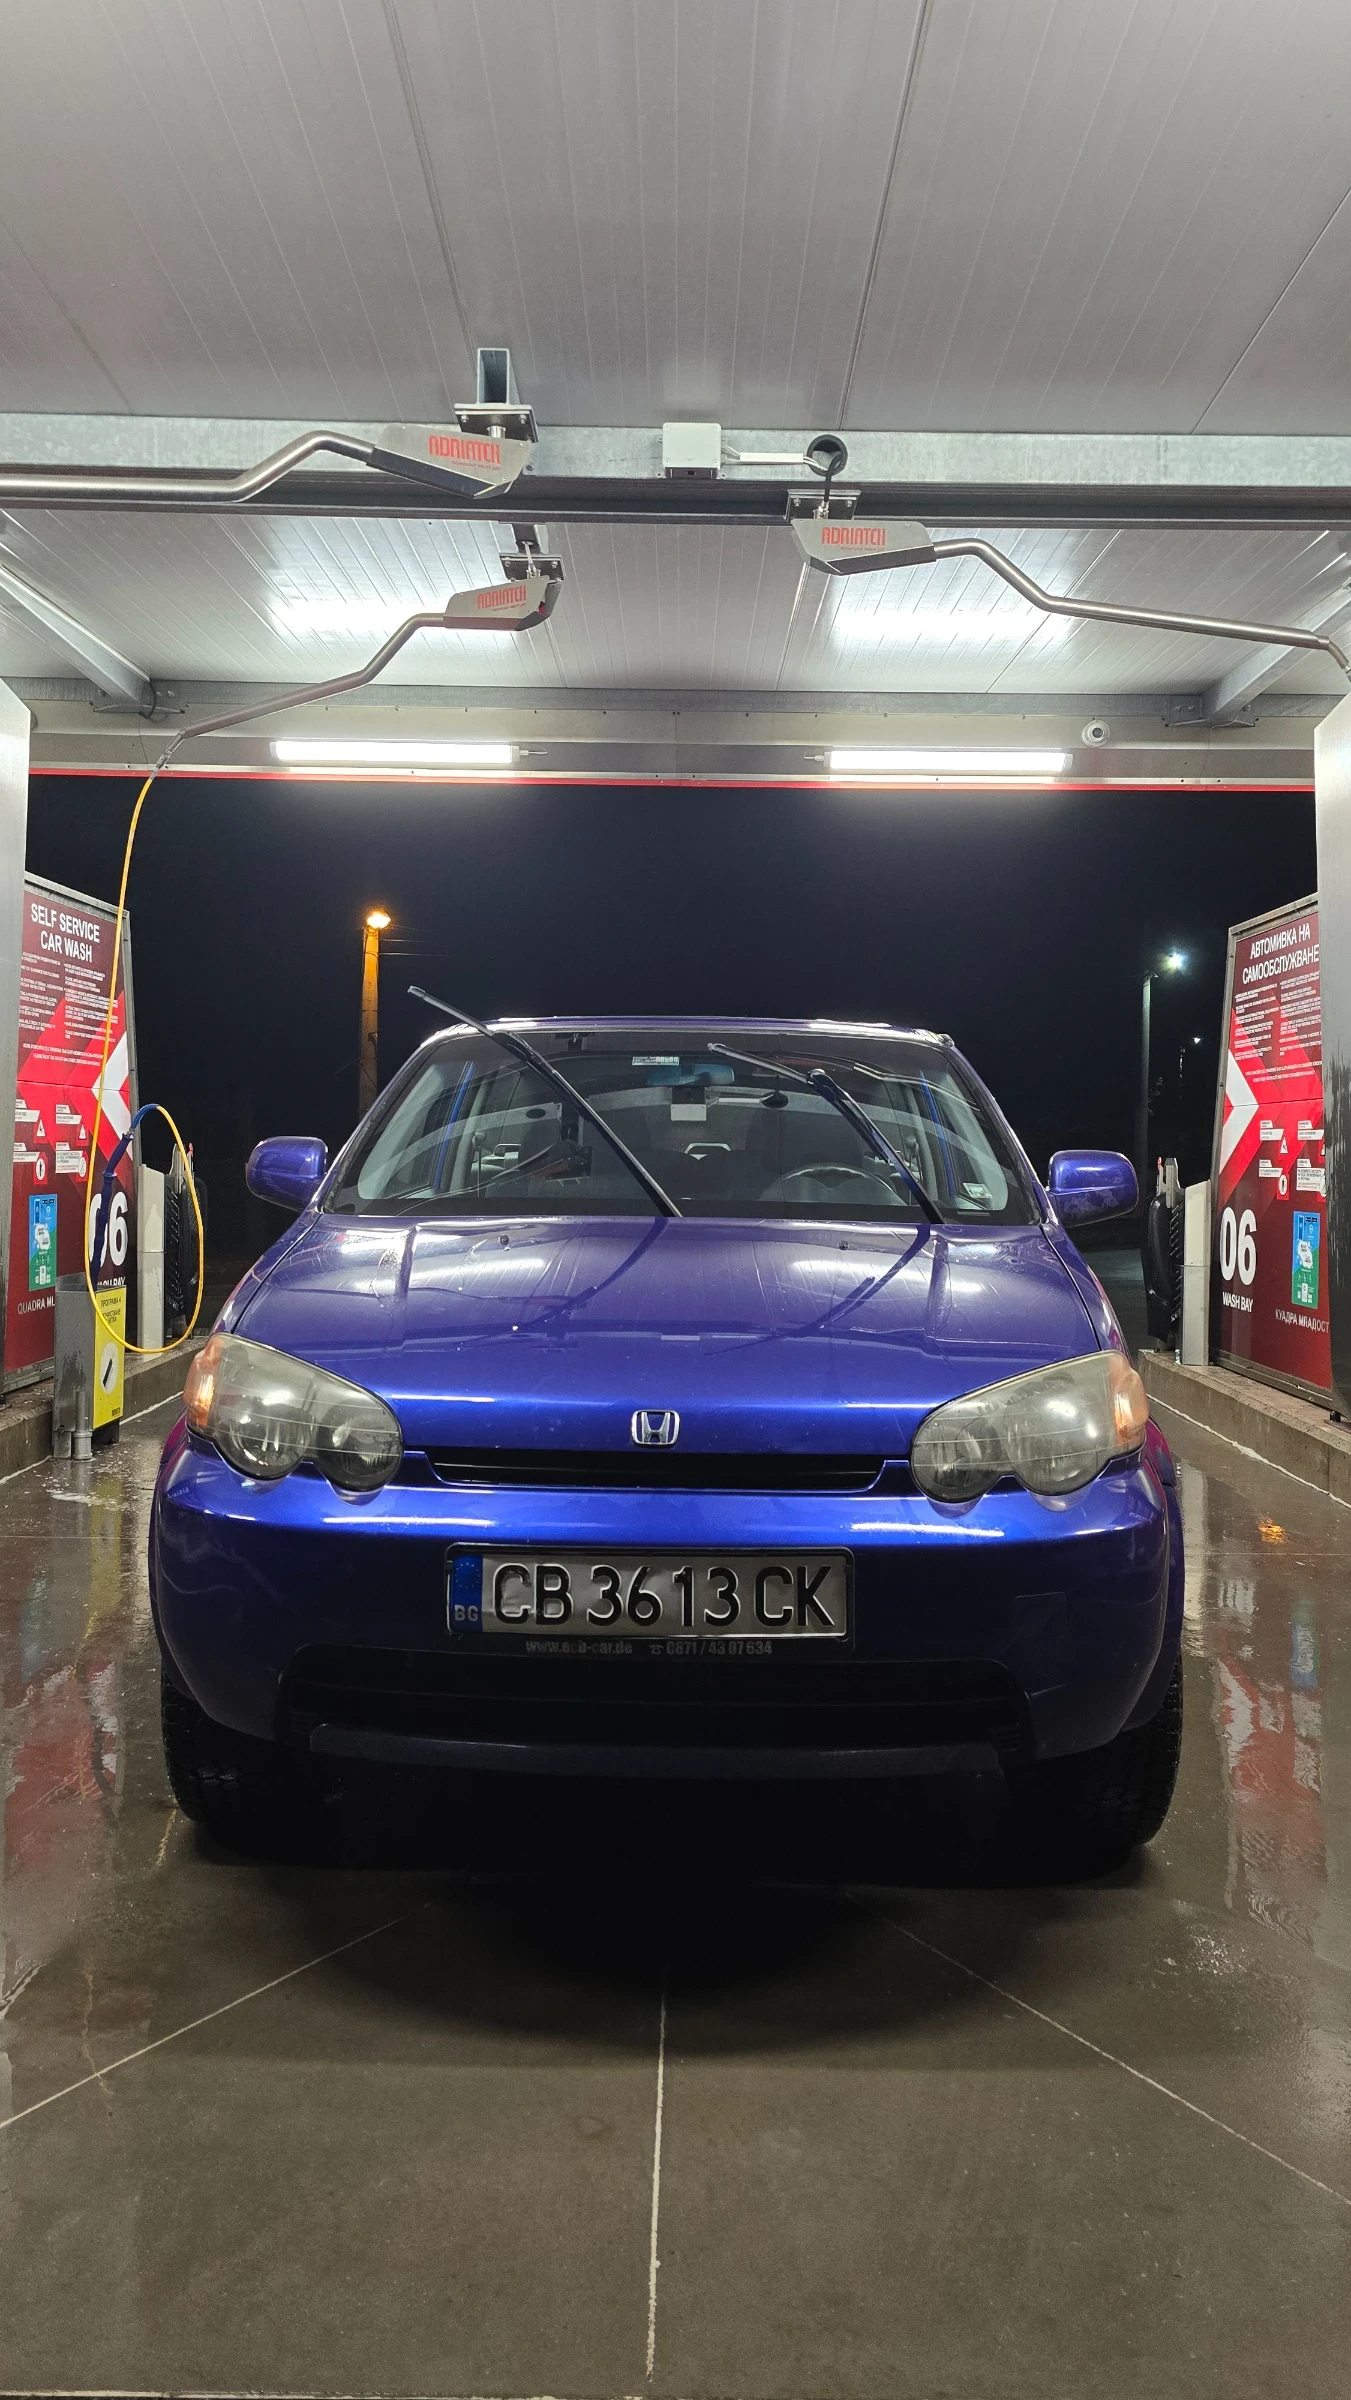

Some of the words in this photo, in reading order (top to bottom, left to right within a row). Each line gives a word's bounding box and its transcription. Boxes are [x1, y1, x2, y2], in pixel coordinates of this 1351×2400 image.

[31, 903, 57, 928] SELF
[59, 913, 100, 943] SERVICE
[40, 930, 63, 954] CAR
[64, 937, 93, 963] WASH
[1250, 927, 1297, 960] АВТОМИВКА
[1298, 922, 1311, 943] НА
[1242, 943, 1320, 985] САМООБСЛУЖВАНЕ
[1220, 1206, 1257, 1286] 06
[17, 1297, 46, 1315] QUADRA
[1222, 1291, 1240, 1310] WASH
[1240, 1296, 1254, 1313] BAY
[1275, 1308, 1298, 1326] КУАДРА
[1298, 1314, 1329, 1334] МЛАДОСТ
[493, 1562, 574, 1626] CB
[586, 1564, 741, 1627] 3613
[754, 1565, 836, 1627] CK
[454, 1604, 479, 1622] BG
